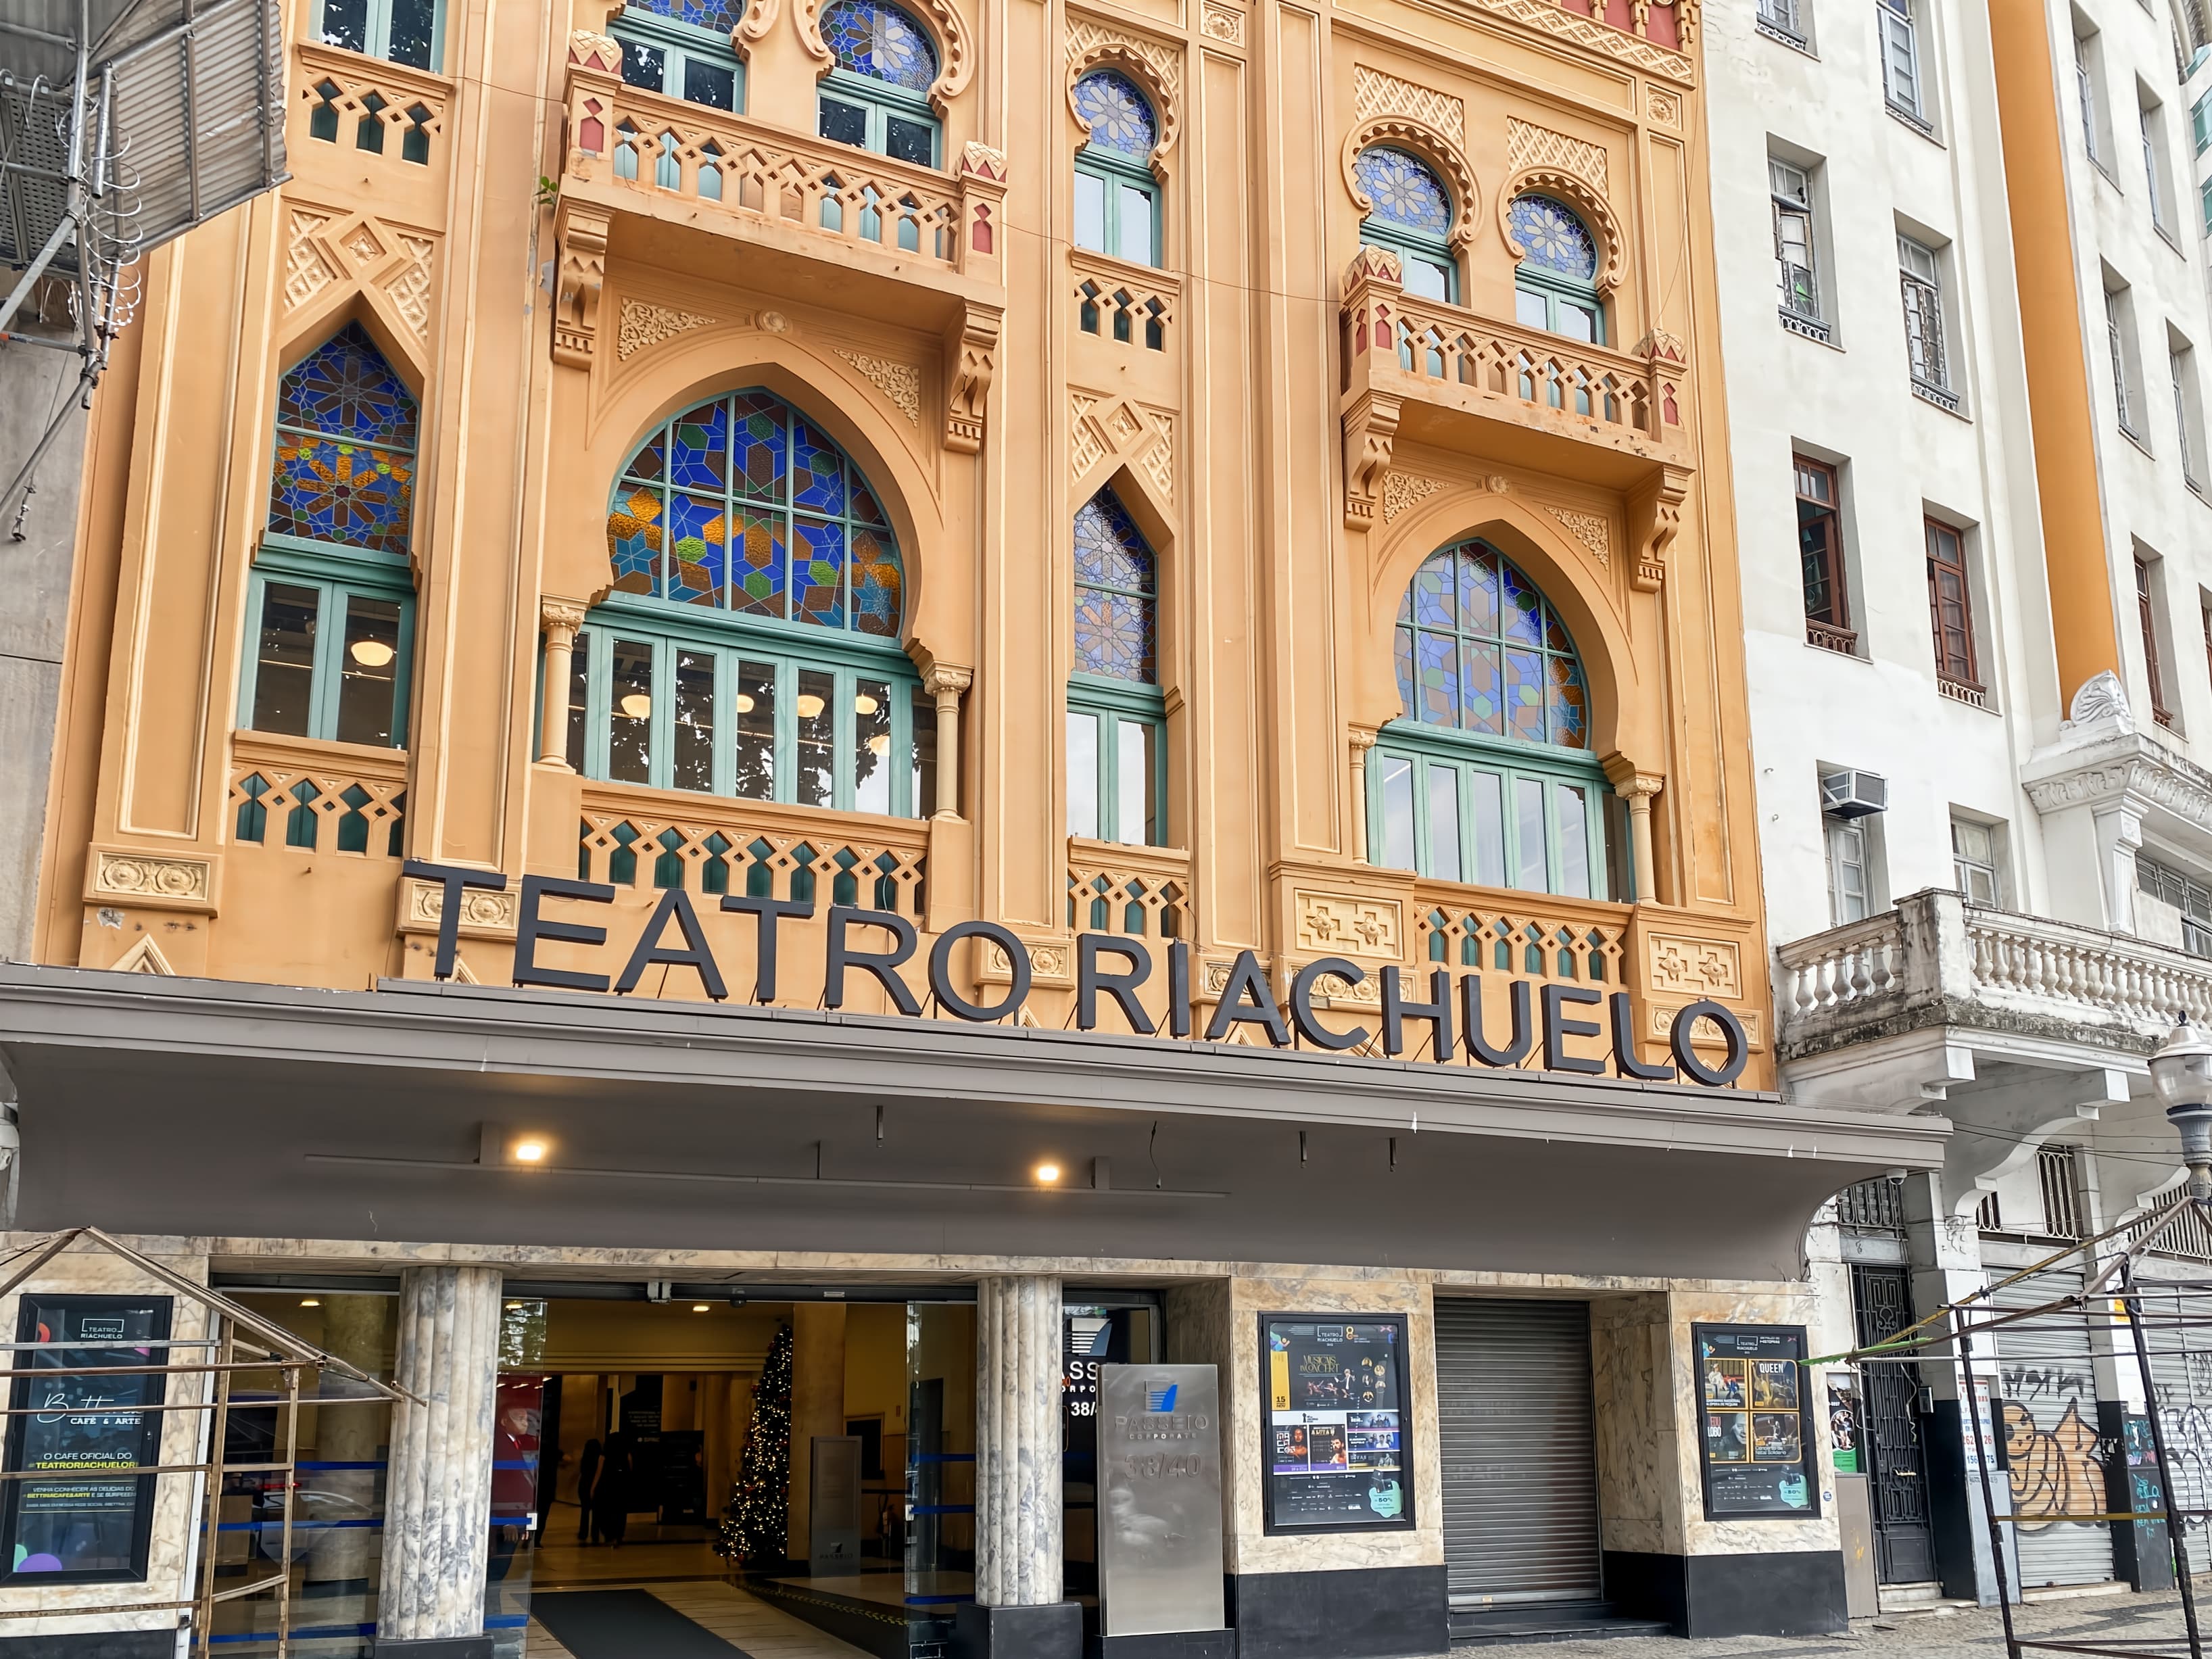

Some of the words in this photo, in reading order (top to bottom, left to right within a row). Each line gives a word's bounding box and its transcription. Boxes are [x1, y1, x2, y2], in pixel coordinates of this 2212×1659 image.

[402, 859, 1032, 1022] TEATRO
[1077, 933, 1750, 1086] RIACHUELO
[1759, 1363, 1784, 1374] QUEEN
[1071, 1401, 1098, 1416] 38/
[1115, 1415, 1209, 1433] PASSEIO
[1707, 1426, 1722, 1437] LOBO
[117, 1452, 133, 1460] DO
[1125, 1452, 1201, 1481] 38/40
